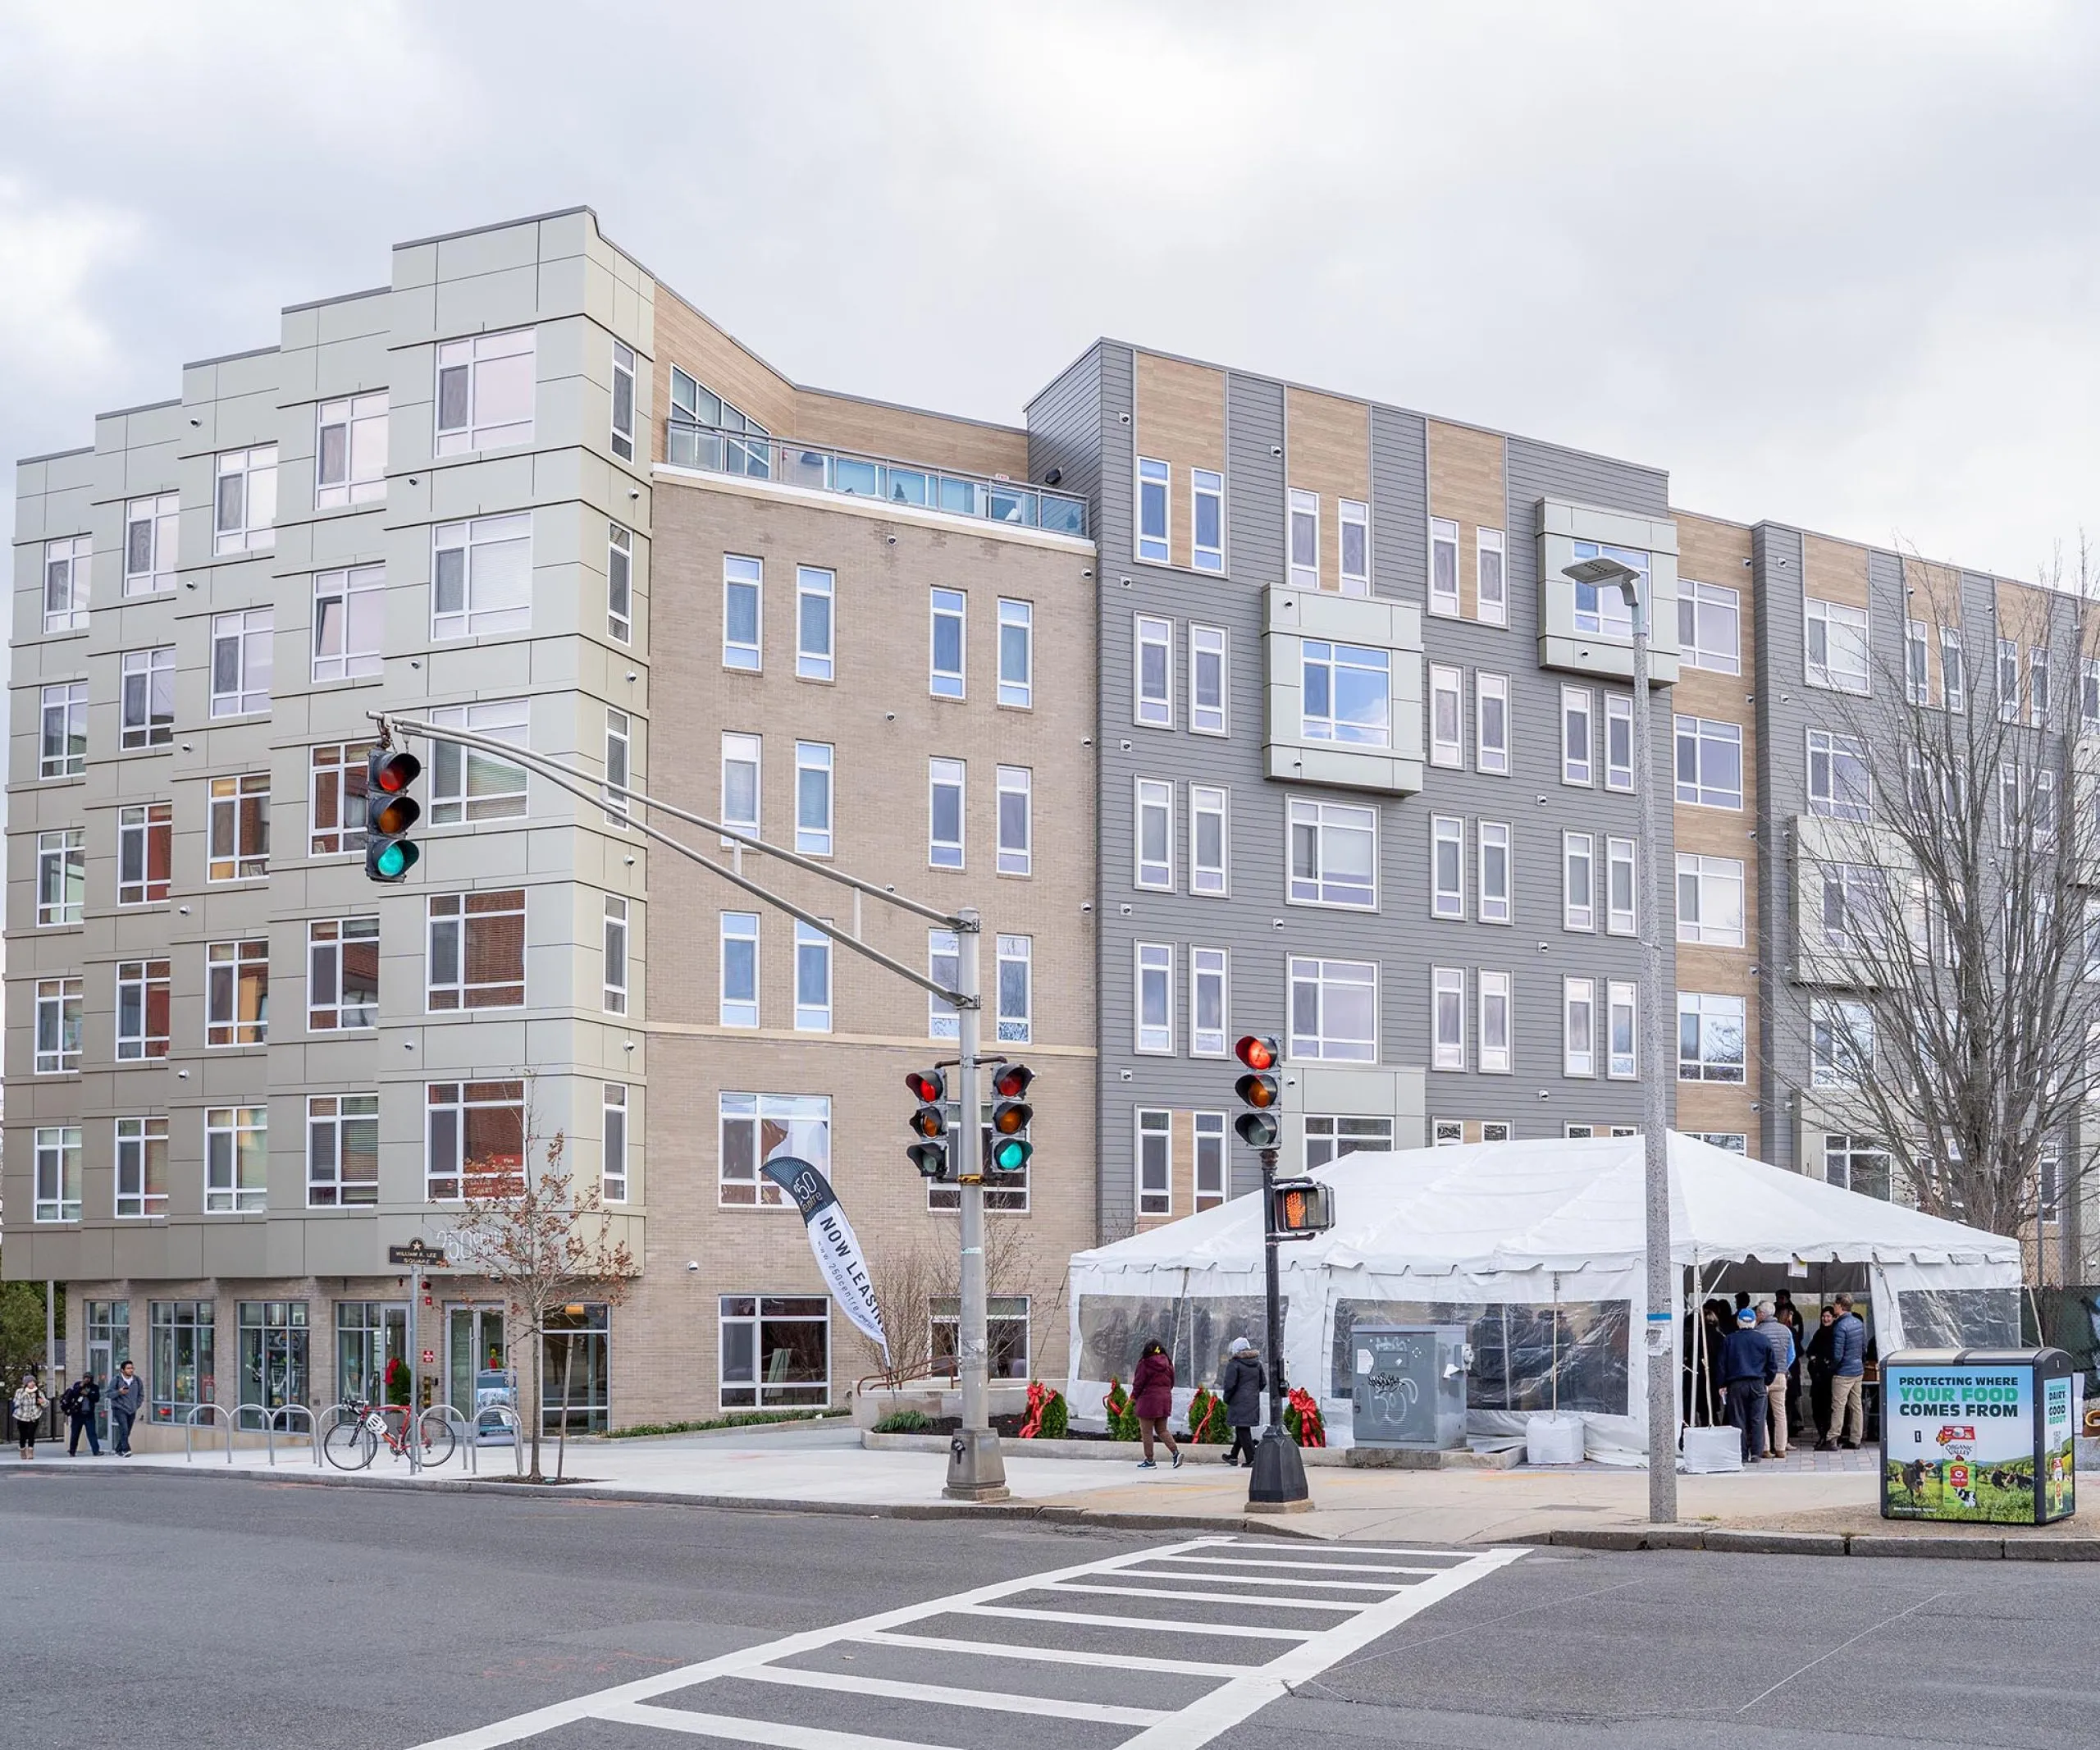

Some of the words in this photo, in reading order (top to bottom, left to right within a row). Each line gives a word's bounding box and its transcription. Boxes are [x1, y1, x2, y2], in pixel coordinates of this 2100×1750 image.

[820, 1216, 851, 1257] NOW
[1899, 1377, 1972, 1386] PROTECTING
[1975, 1377, 2019, 1386] WHERE
[1899, 1387, 1956, 1402] YOUR
[1961, 1387, 2019, 1402] FOOD
[2048, 1391, 2066, 1401] DAIRY
[1899, 1404, 1961, 1417] COMES
[1965, 1404, 2019, 1418] FROM
[2048, 1405, 2066, 1416] GOOD
